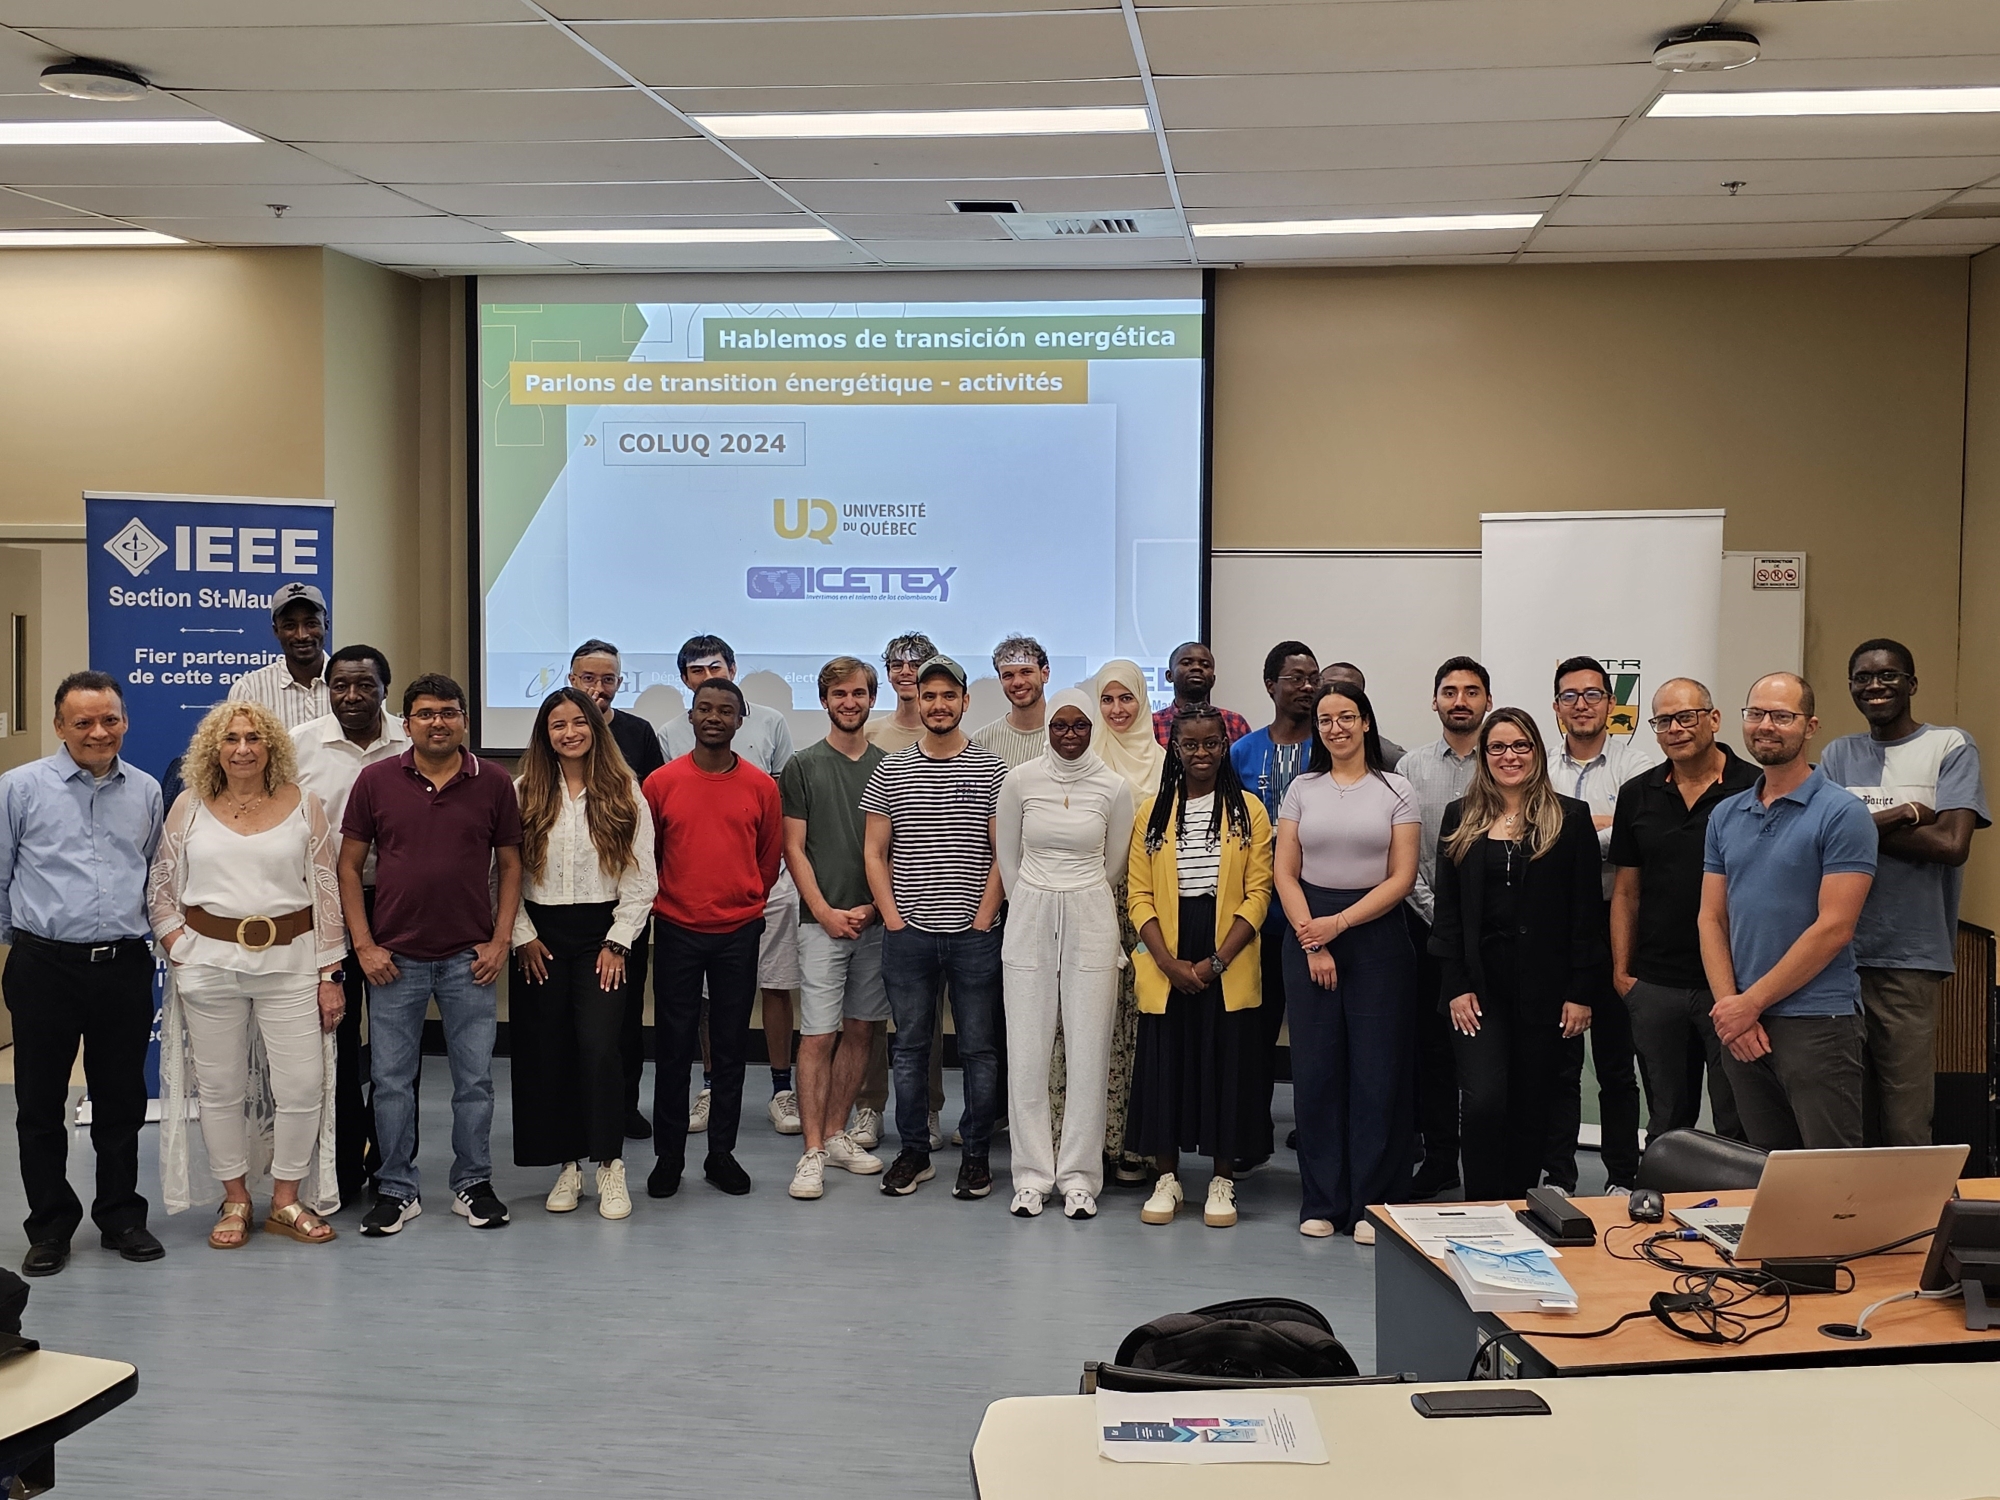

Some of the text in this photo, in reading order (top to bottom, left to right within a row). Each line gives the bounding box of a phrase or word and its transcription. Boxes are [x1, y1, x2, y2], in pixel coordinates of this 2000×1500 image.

[719, 326, 1175, 351] Hablemos de transición energética
[525, 374, 616, 392] Parlons
[623, 374, 653, 392] de
[660, 374, 778, 392] transition
[785, 372, 933, 396] énergétique
[958, 372, 1063, 392] activités
[619, 433, 787, 457] COLUQ 2024
[773, 498, 838, 545] UQ
[843, 503, 926, 518] UNIVERSITÉ
[843, 520, 917, 536] DU QUÉBEC
[175, 525, 319, 574] IEEE
[807, 567, 957, 602] ICETEX
[109, 586, 273, 609] Section St-Mau
[135, 648, 287, 668] Fier partenaire
[129, 668, 154, 684] de
[161, 670, 213, 685] cette
